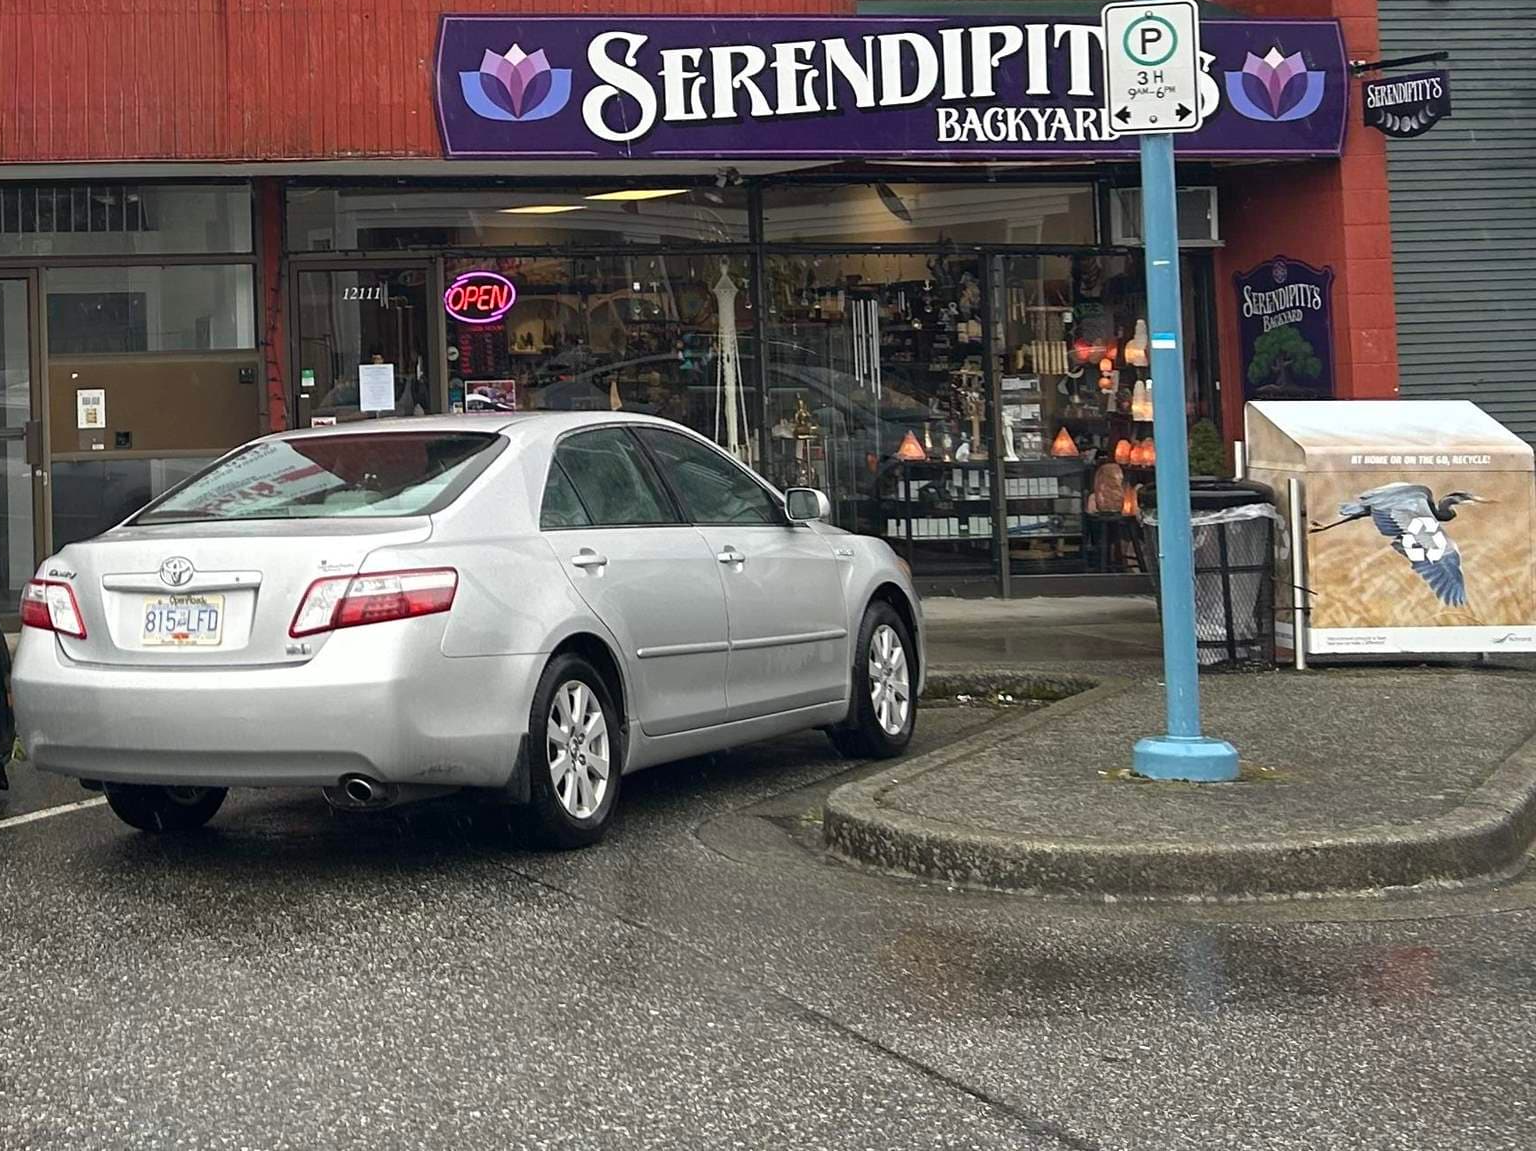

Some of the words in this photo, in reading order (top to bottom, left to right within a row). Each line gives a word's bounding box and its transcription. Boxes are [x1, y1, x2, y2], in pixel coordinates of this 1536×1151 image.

[1140, 28, 1162, 55] P
[581, 23, 1220, 142] SERENDIPITS
[1137, 71, 1148, 85] 3
[1153, 70, 1164, 83] H
[448, 285, 509, 311] OPEN
[1351, 455, 1363, 465] AT
[1364, 455, 1388, 465] HOME
[1390, 455, 1402, 465] OR
[1404, 455, 1417, 465] ON
[1418, 455, 1434, 465] THE
